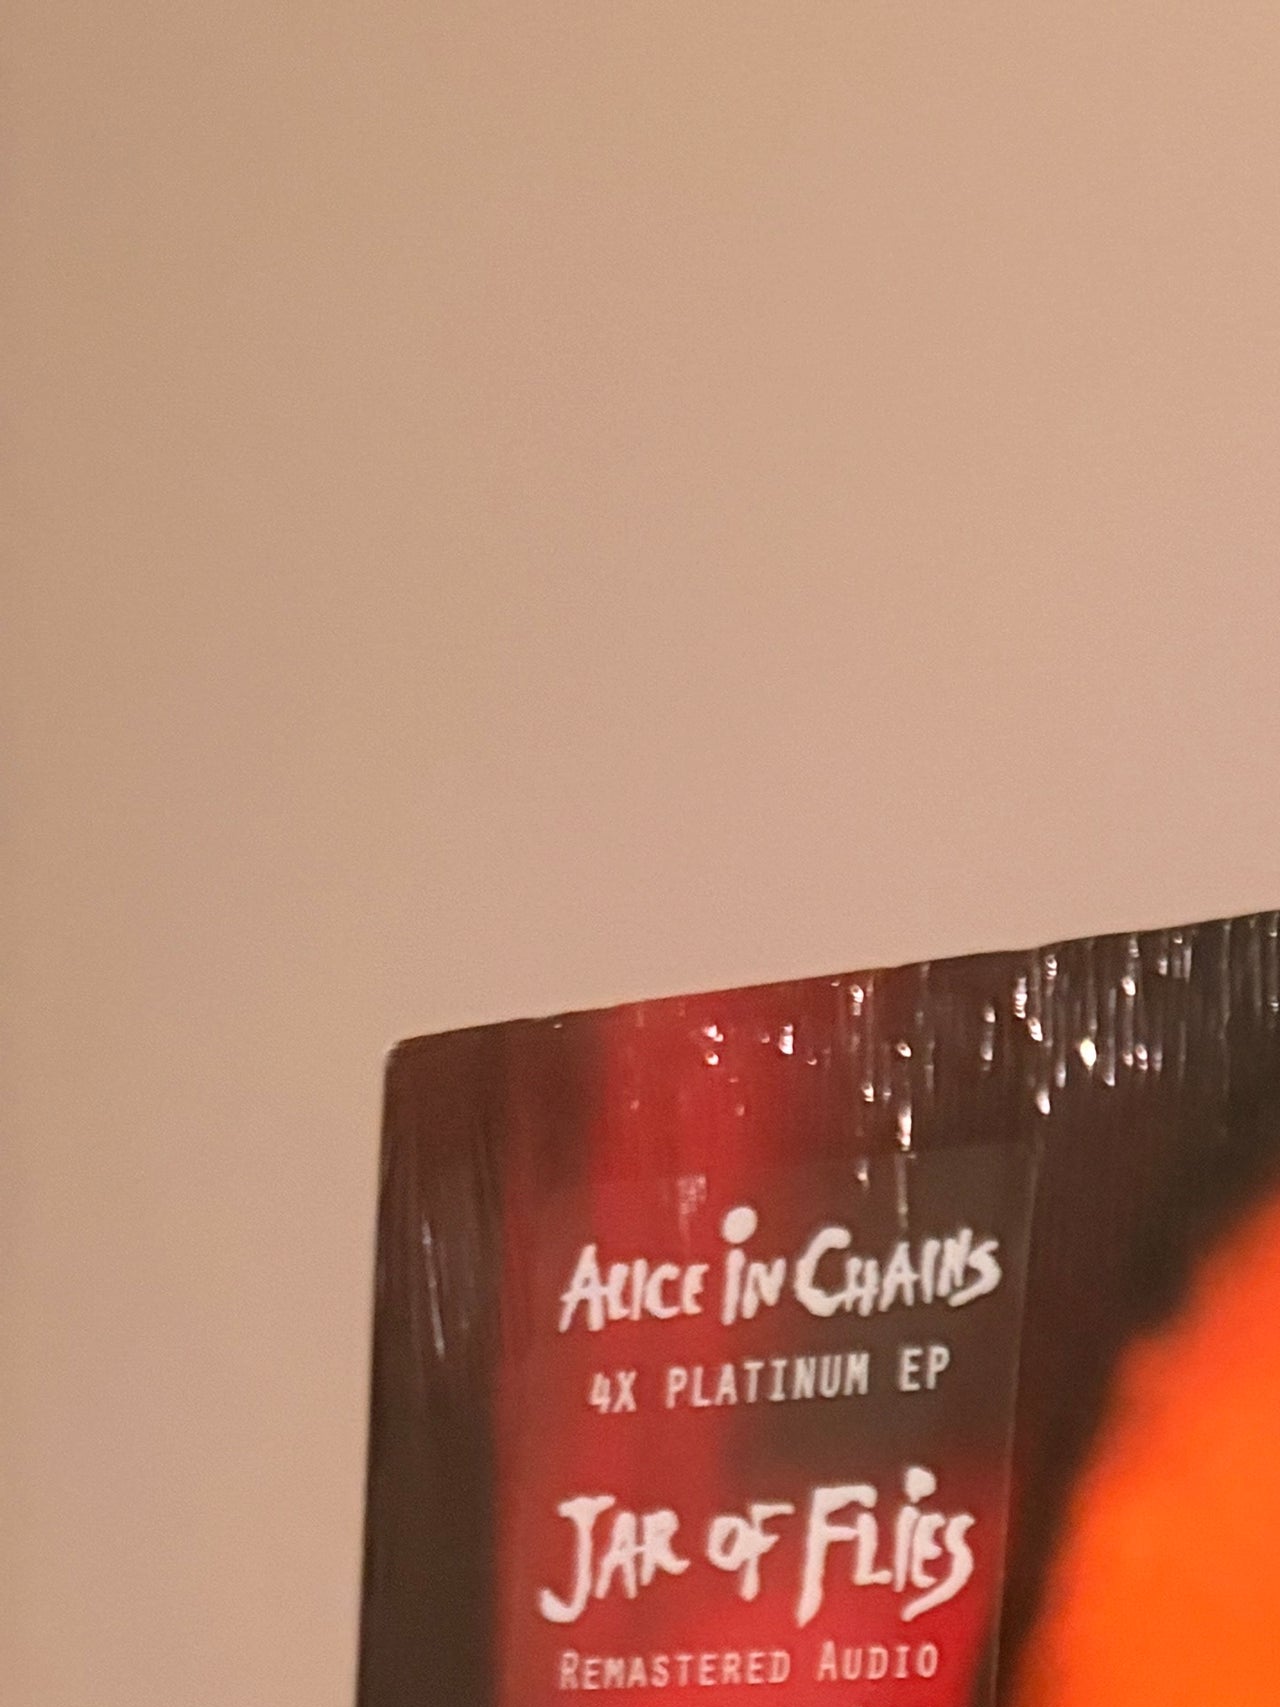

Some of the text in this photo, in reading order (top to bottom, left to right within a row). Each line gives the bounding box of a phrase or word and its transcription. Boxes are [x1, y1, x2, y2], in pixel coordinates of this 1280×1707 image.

[590, 1343, 952, 1415] 4X PLATINUM EP
[538, 1494, 691, 1624] JAR
[706, 1500, 797, 1603] OF
